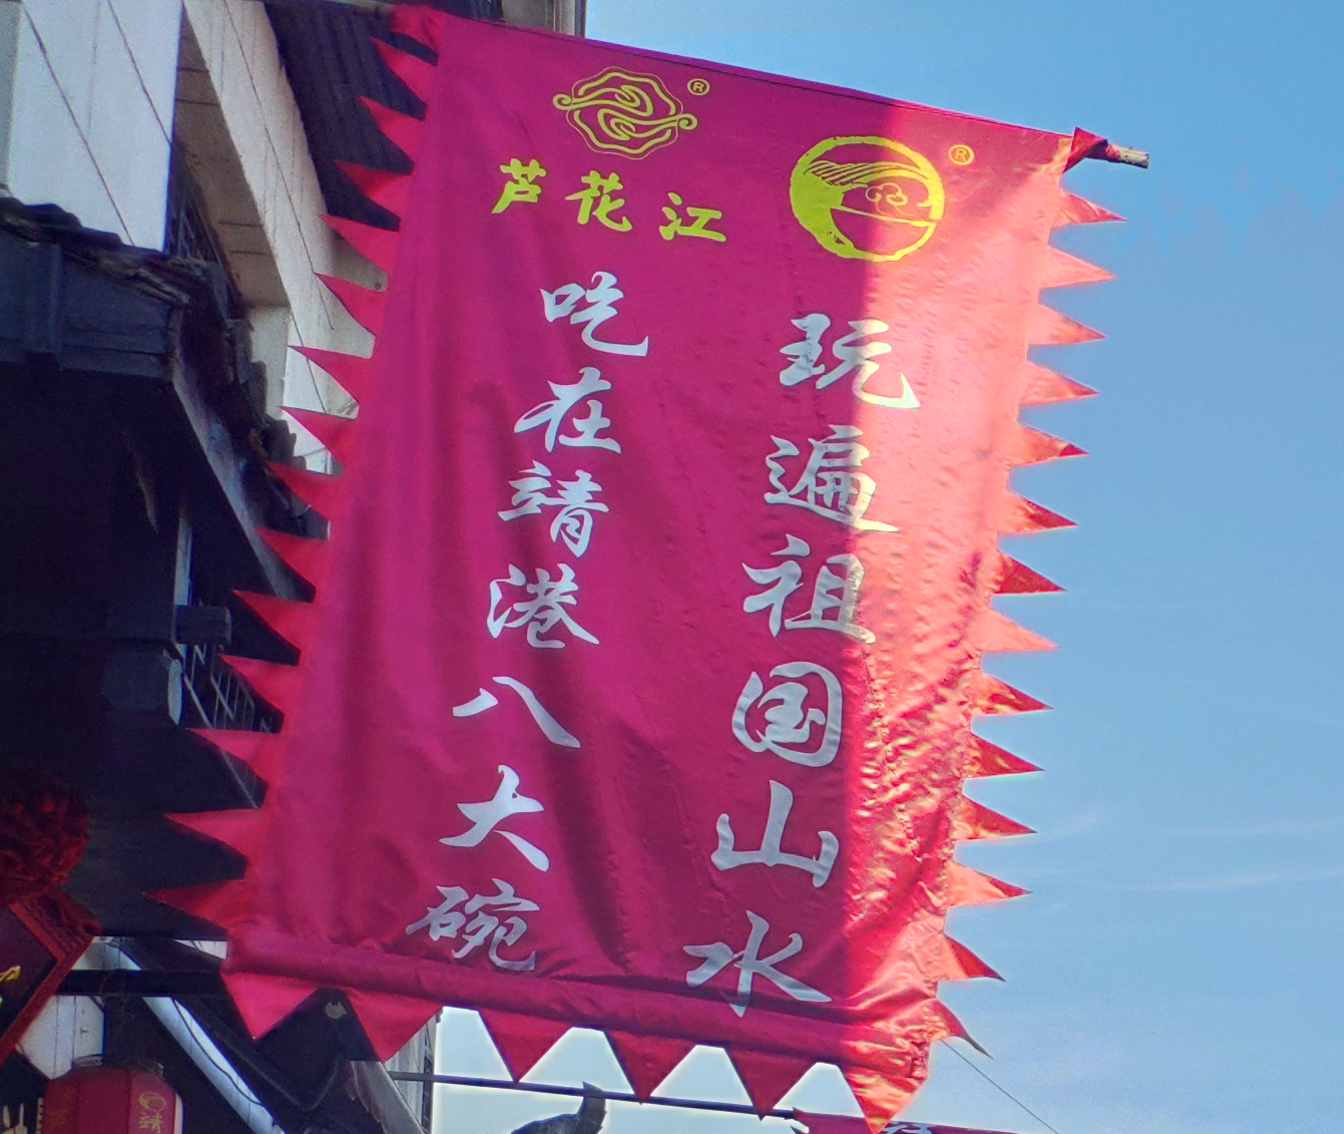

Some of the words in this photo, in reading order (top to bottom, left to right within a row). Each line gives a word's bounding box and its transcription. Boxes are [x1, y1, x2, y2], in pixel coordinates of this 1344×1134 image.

[492, 157, 727, 243] 芦花江
[405, 270, 649, 972] 吃在靖港八大碗
[682, 312, 921, 1018] 玩遍祖国山水
